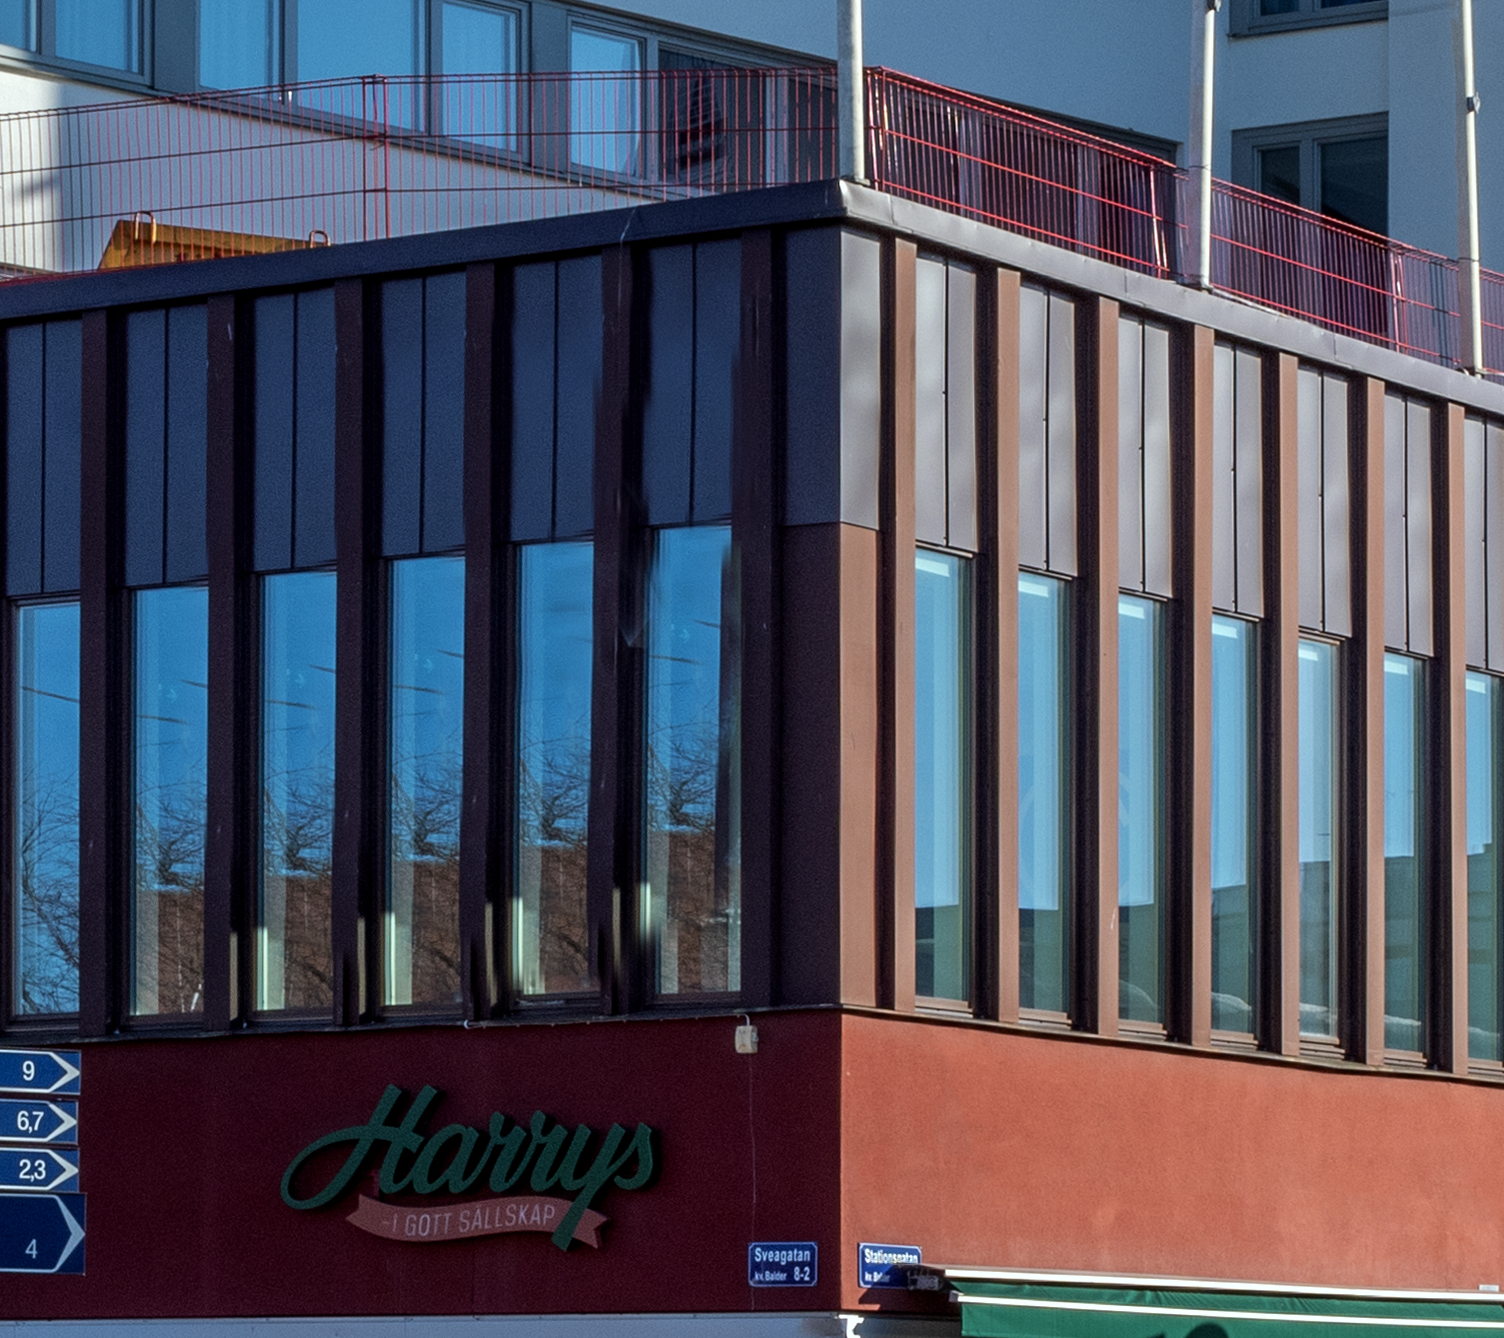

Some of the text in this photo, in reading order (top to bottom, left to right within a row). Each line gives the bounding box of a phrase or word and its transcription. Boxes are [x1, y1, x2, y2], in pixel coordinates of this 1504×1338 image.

[22, 1061, 36, 1081] 9
[17, 1111, 45, 1134] 6,7
[19, 1159, 46, 1182] 2,3
[280, 1083, 654, 1252] Harrys
[404, 1212, 453, 1238] GOTT
[25, 1239, 38, 1259] 4
[754, 1247, 811, 1266] Sveagatan
[794, 1266, 810, 1282] 8-2
